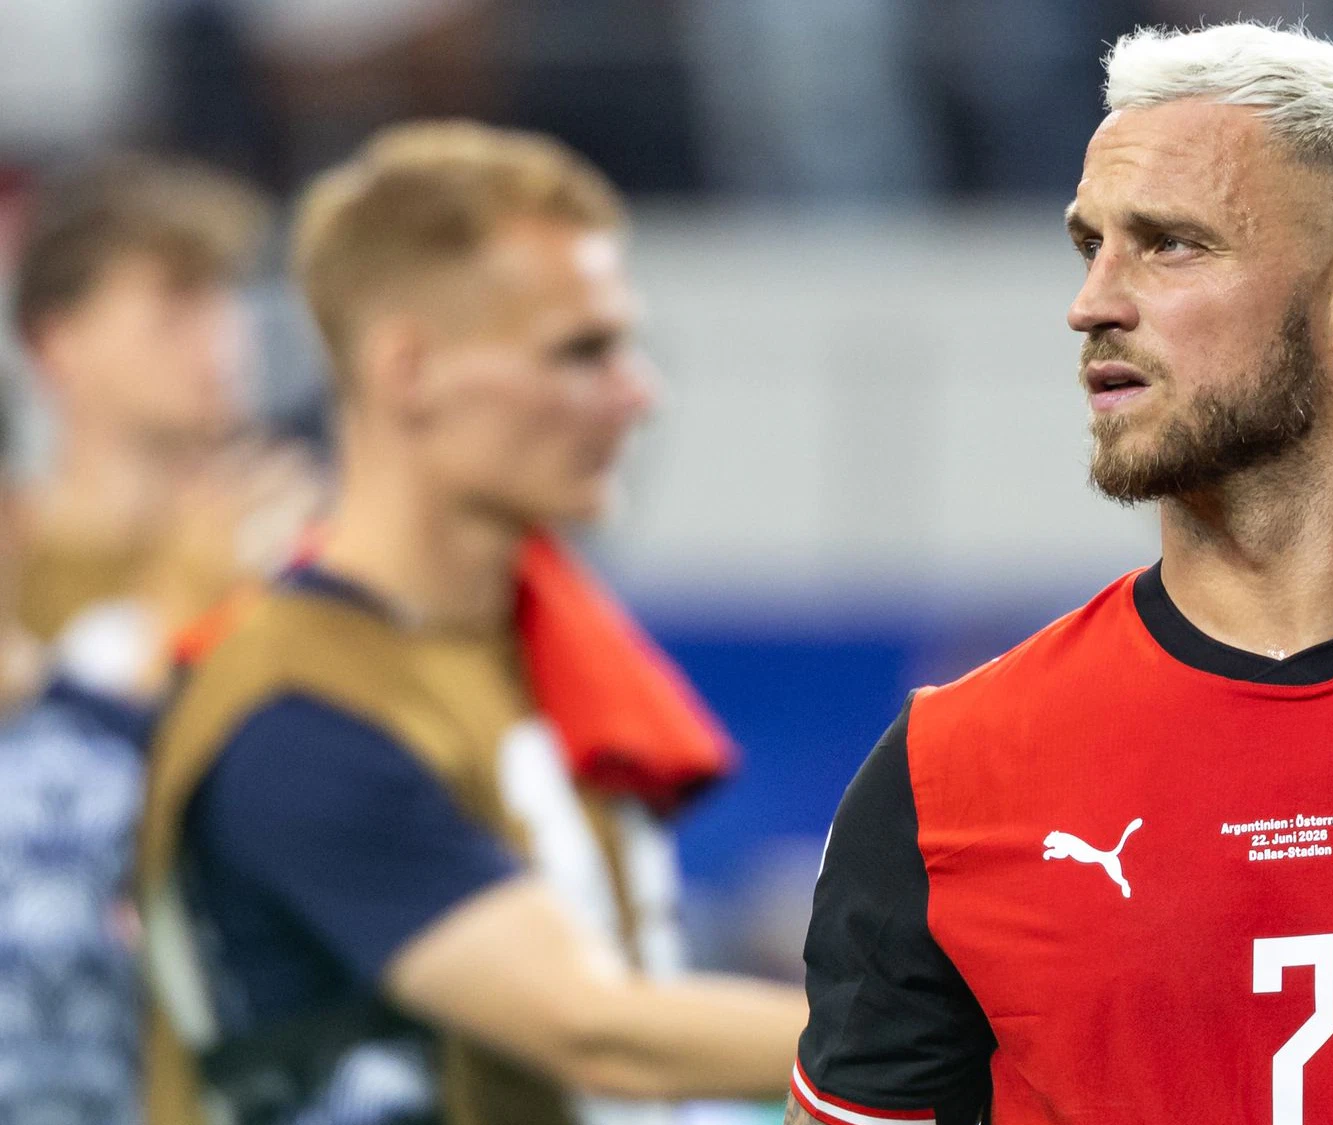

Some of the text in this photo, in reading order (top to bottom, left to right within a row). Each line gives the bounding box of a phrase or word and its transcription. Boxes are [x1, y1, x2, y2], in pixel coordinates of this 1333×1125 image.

[1221, 818, 1289, 836] Argentinien
[1251, 829, 1328, 847] 22. Juni 2026
[1248, 844, 1332, 862] Dallas-Stadion
